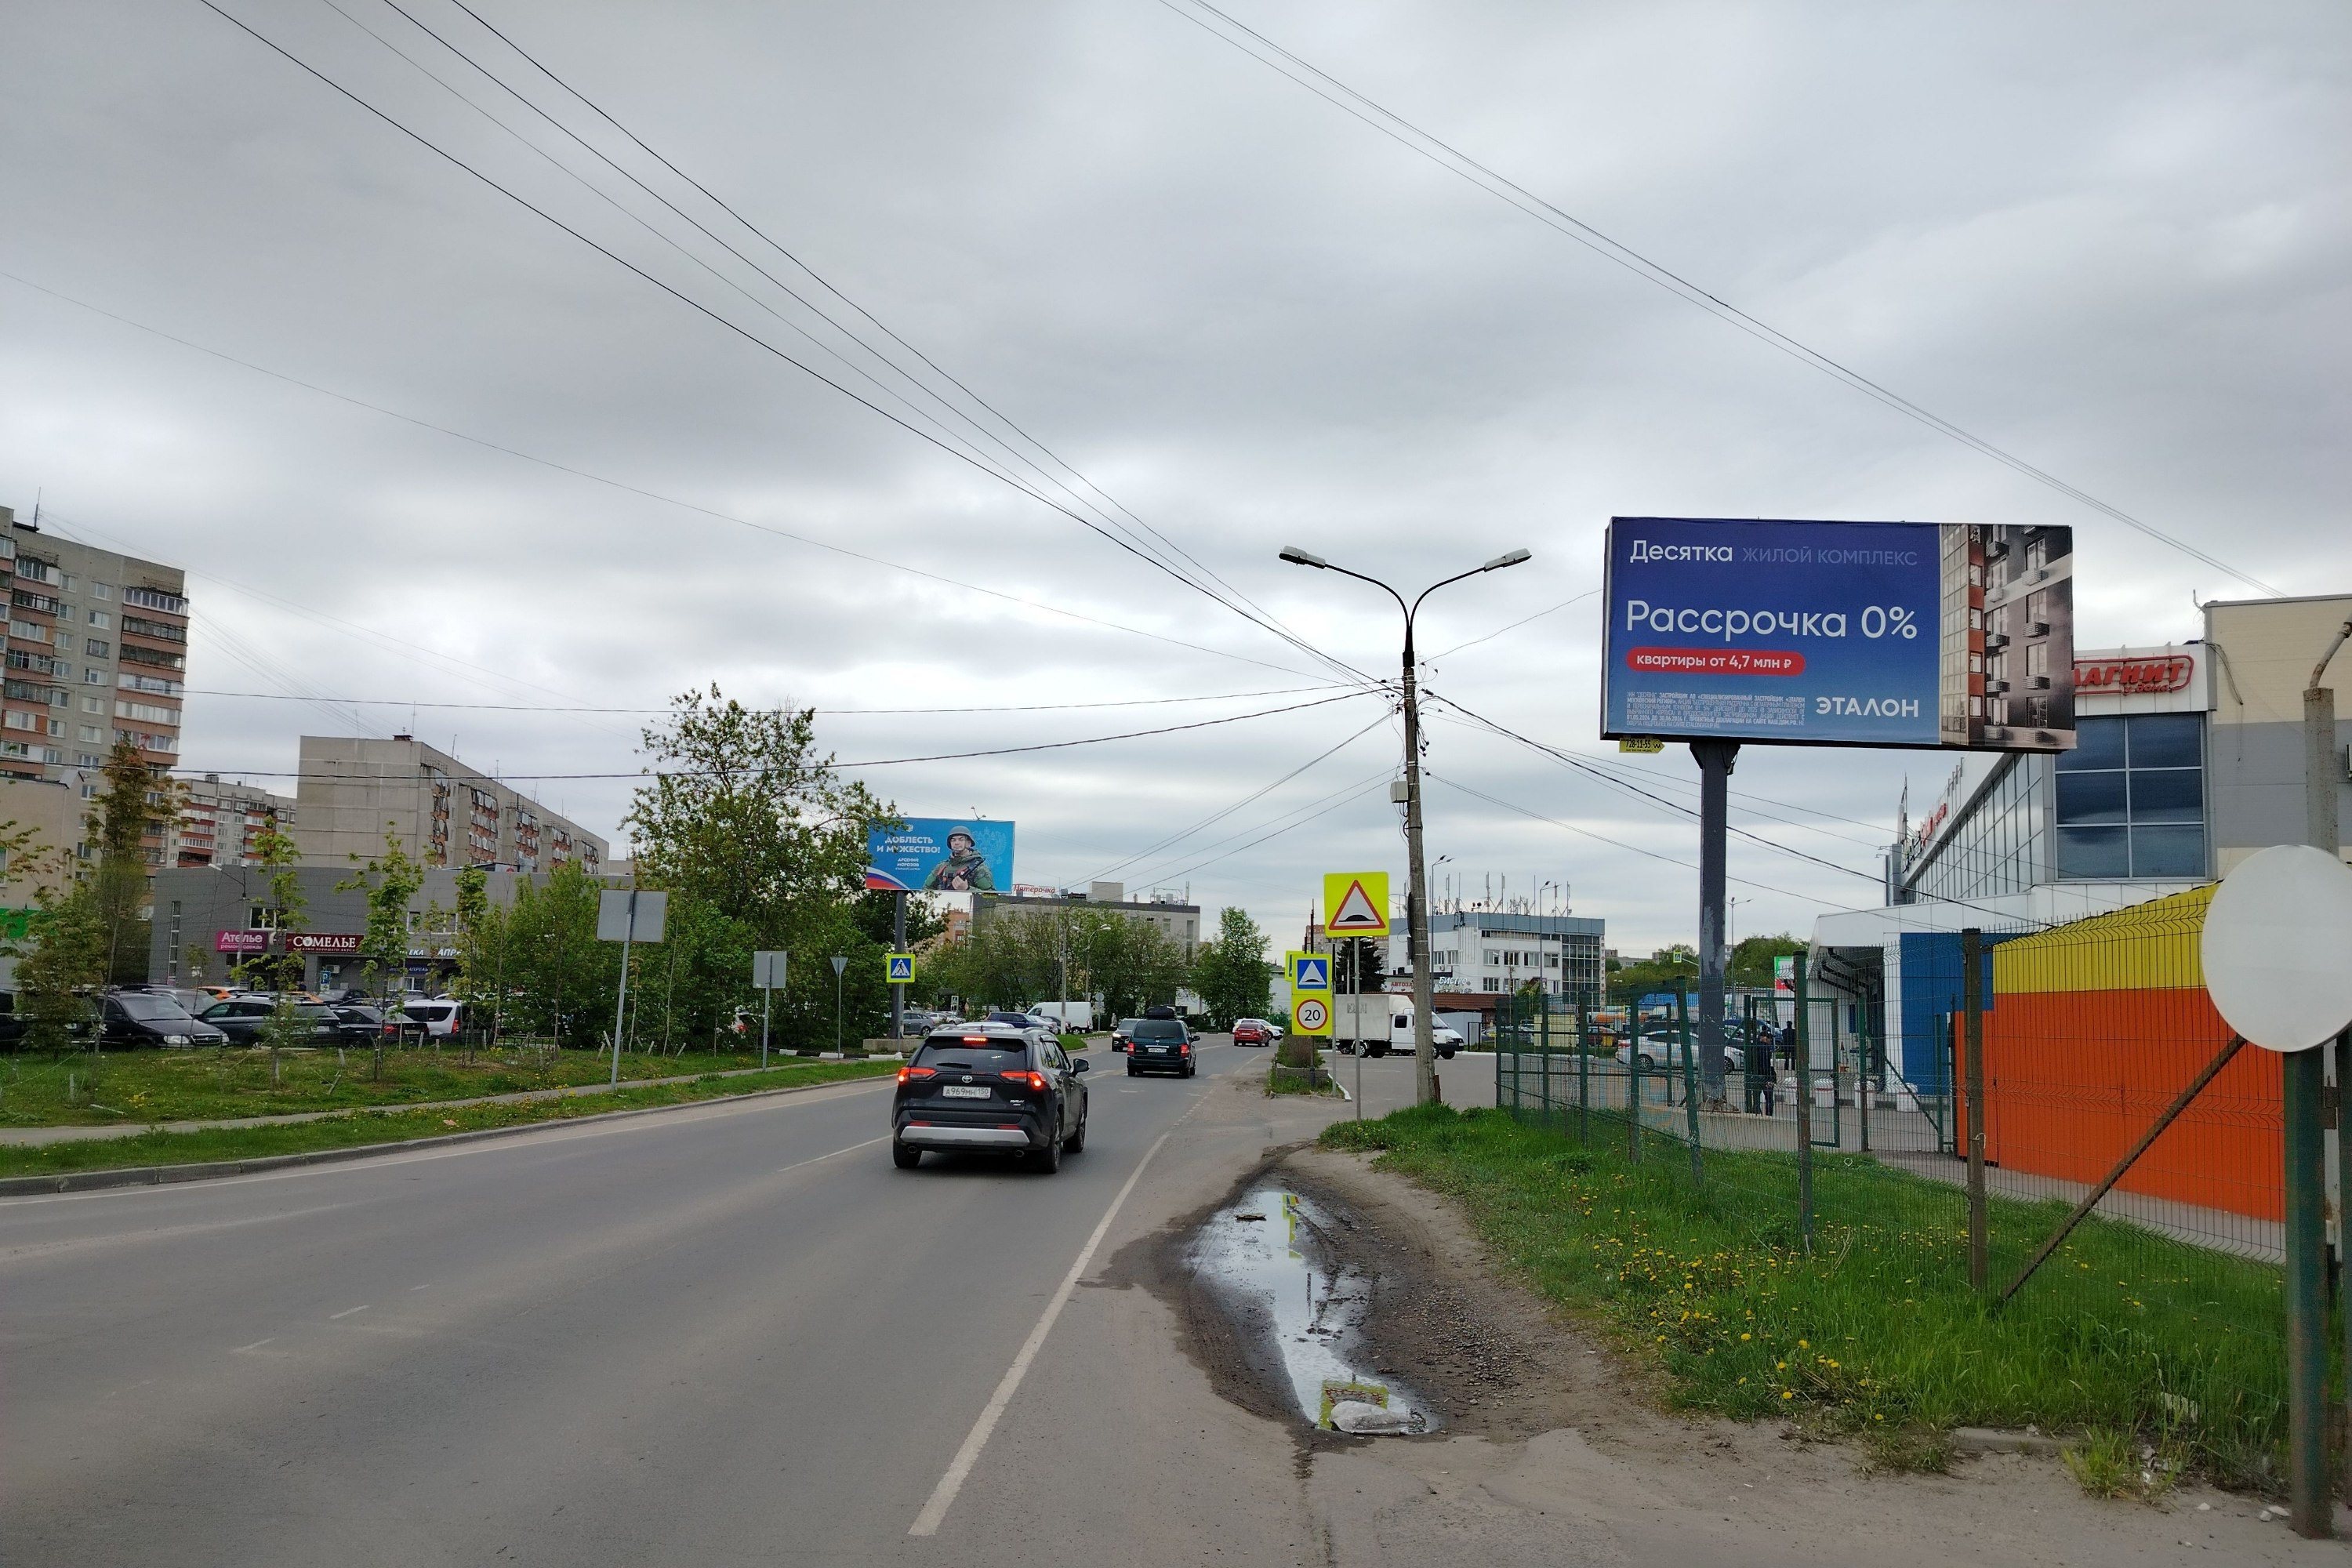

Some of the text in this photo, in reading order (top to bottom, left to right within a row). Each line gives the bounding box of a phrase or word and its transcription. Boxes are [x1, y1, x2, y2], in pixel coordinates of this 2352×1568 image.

[1630, 540, 1918, 566] Десятка ЖИЛОЙ КОМПЛЕКС
[1627, 601, 1918, 641] Рассрочка 0%
[1636, 654, 1706, 670] квартиры
[1710, 657, 1726, 668] от
[1729, 655, 1750, 670] 4,7
[1754, 659, 1780, 669] млн
[1816, 697, 1919, 718] ЭТАЛОН
[221, 932, 263, 942] Ателье
[293, 936, 356, 947] СОМЕЛЬЕ
[1305, 1009, 1321, 1022] 20
